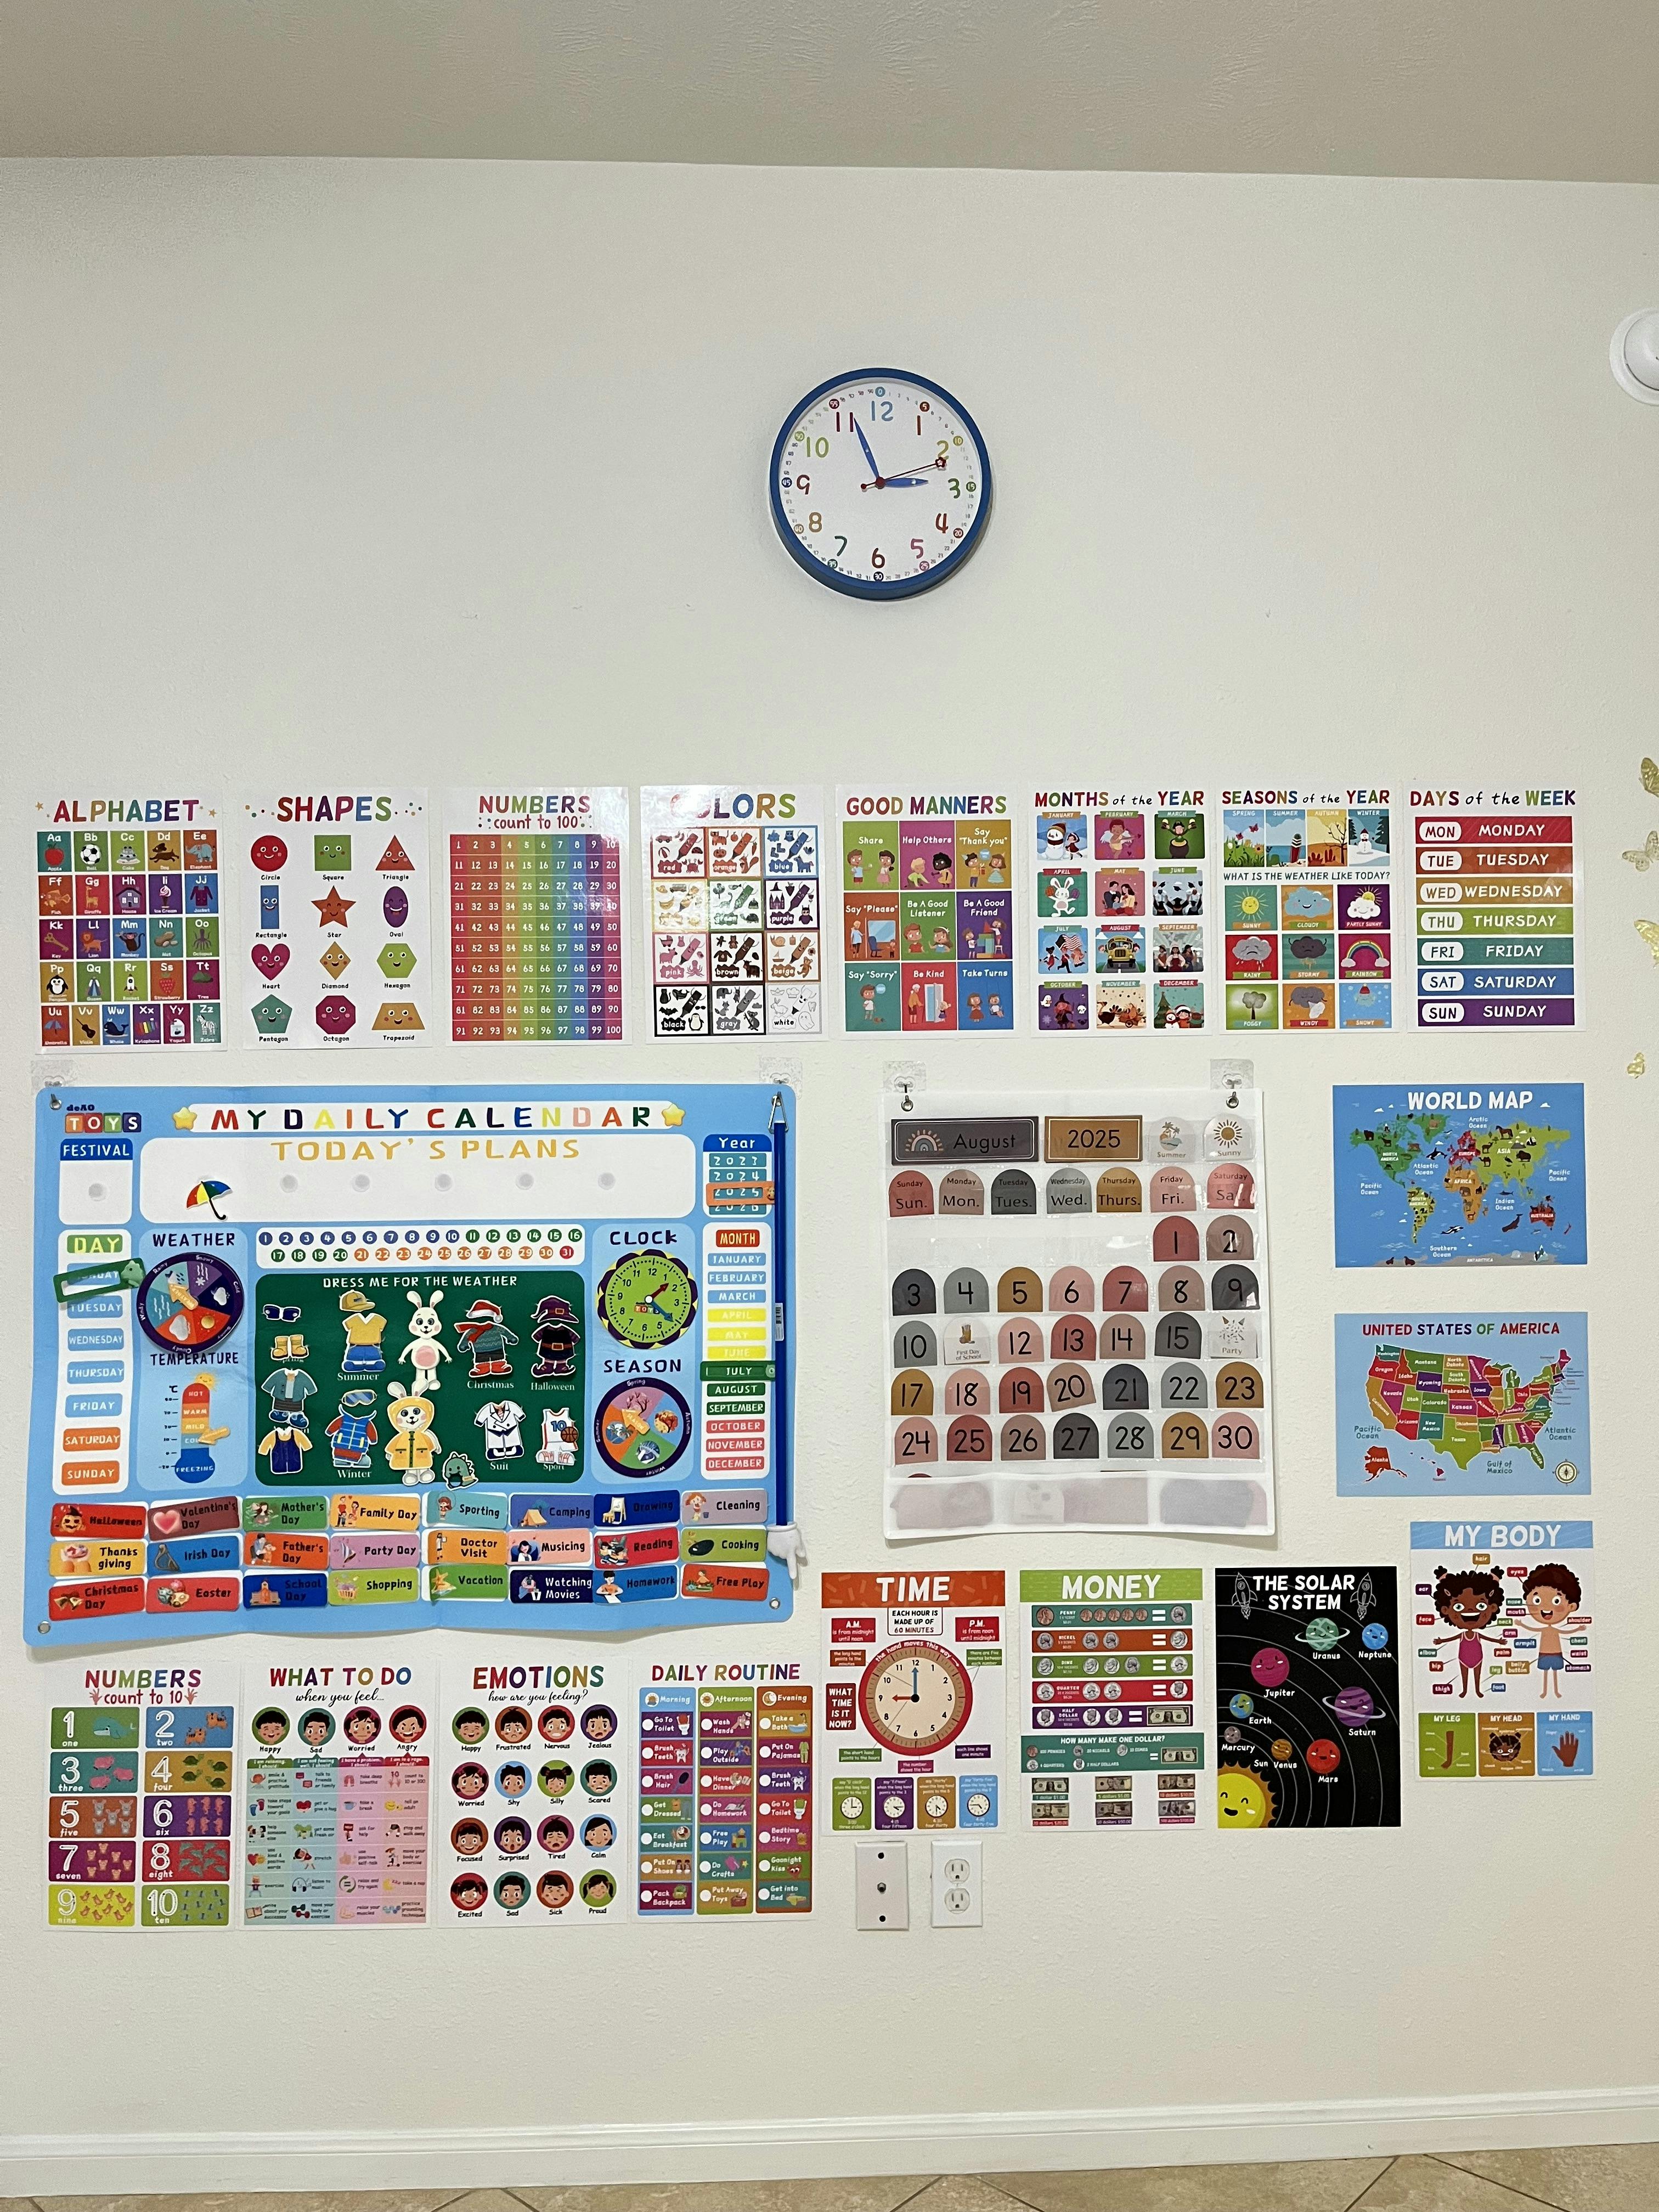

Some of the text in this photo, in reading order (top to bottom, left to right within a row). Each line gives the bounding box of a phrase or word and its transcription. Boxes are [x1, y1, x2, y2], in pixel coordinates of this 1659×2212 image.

[872, 401, 893, 421] 12
[806, 437, 828, 458] 10
[948, 478, 960, 499] 3
[809, 512, 822, 532] 8
[1035, 791, 1204, 807] MONTHS of the YEAR
[1222, 790, 1389, 804] SEASONS of the YEAR
[1410, 790, 1576, 806] DAYS of the WEEK
[54, 800, 199, 822] ALPHABET
[277, 795, 391, 822] SHAPES
[479, 795, 590, 814] NUMBERS
[847, 796, 1006, 815] GOOD MANNERS
[494, 814, 578, 829] count to 100
[193, 831, 207, 840] Ee
[1425, 824, 1545, 838] MON MONDAY
[858, 836, 883, 844] Share
[902, 836, 952, 846] Help Others
[322, 874, 345, 882] Square
[1223, 871, 1390, 881] WHAT IS THE WEATHER LIKE TODAY?
[1426, 885, 1563, 899] WED WEDNESDAY
[1431, 945, 1544, 958] FRI FRIDAY
[716, 967, 739, 977] brown
[925, 969, 944, 978] Kind
[962, 969, 1008, 978] Take Turns
[1429, 1005, 1547, 1019] SUN SUNDAY
[606, 1026, 622, 1035] 100
[664, 1019, 685, 1029] black
[1408, 1091, 1532, 1110] WORLD MAP
[67, 1116, 137, 1131] TOYS
[211, 1107, 650, 1130] MY DAILY CALENDAR
[719, 1137, 755, 1149] Year
[953, 1129, 1120, 1153] August 2025
[63, 1144, 130, 1156] FESTIVAL
[270, 1138, 579, 1161] TODAY'S PLANS
[713, 1156, 758, 1166] 2023
[896, 1198, 927, 1210] Sun.
[943, 1195, 980, 1207] Mon.
[1050, 1194, 1087, 1206] Wed.
[1098, 1194, 1141, 1206] Thurs.
[73, 1237, 120, 1252] DAY
[153, 1233, 234, 1246] WEATHER
[610, 1230, 677, 1245] CLOCK
[720, 1232, 755, 1245] MONTH
[908, 1284, 920, 1306] 3
[1065, 1280, 1079, 1303] 6
[1363, 1322, 1560, 1336] UNITED STATES OF AMERICA
[69, 1335, 123, 1345] WEDNESDAY
[1010, 1331, 1031, 1355] 12
[1167, 1326, 1188, 1350] 15
[150, 1352, 239, 1365] TEMPERATURE
[604, 1359, 681, 1373] SEASON
[337, 1372, 377, 1381] Summer
[531, 1381, 575, 1391] Halloween
[65, 1434, 120, 1446] SATURDAY
[1218, 1425, 1252, 1449] 30
[708, 1459, 761, 1469] DECEMBER
[1487, 1460, 1512, 1469] Gulf of
[716, 1499, 760, 1511] Cleaning
[360, 1507, 417, 1521] Family Day
[461, 1538, 498, 1548] Doctor
[1445, 1525, 1561, 1548] MY BODY
[721, 1539, 759, 1551] Cooking
[366, 1578, 413, 1591] Shopping
[458, 1575, 503, 1585] Vacation
[1063, 1575, 1161, 1599] MONEY
[1252, 1575, 1355, 1591] THE SOLAR
[876, 1577, 950, 1601] TIME
[1268, 1594, 1342, 1610] SYSTEM
[86, 1669, 201, 1688] NUMBERS
[270, 1667, 411, 1686] WHAT TO DO
[473, 1666, 603, 1689] EMOTIONS
[652, 1664, 800, 1681] DAILY ROUTINE
[104, 1689, 182, 1704] count to 10
[488, 1690, 508, 1702] how
[527, 1695, 548, 1706] you
[549, 1689, 588, 1705] feeling?
[776, 1694, 807, 1703] Evening
[1263, 1689, 1295, 1697] Jupiter
[659, 1696, 691, 1705] Morning
[829, 1720, 852, 1728] NOW?
[1133, 1735, 1165, 1743] DOLLAR?
[1348, 1728, 1376, 1736] Saturn
[156, 1738, 173, 1746] two
[1221, 1743, 1255, 1753] Mercury
[713, 1747, 729, 1757] Play
[154, 1799, 172, 1827] 6
[151, 1842, 170, 1870] 8
